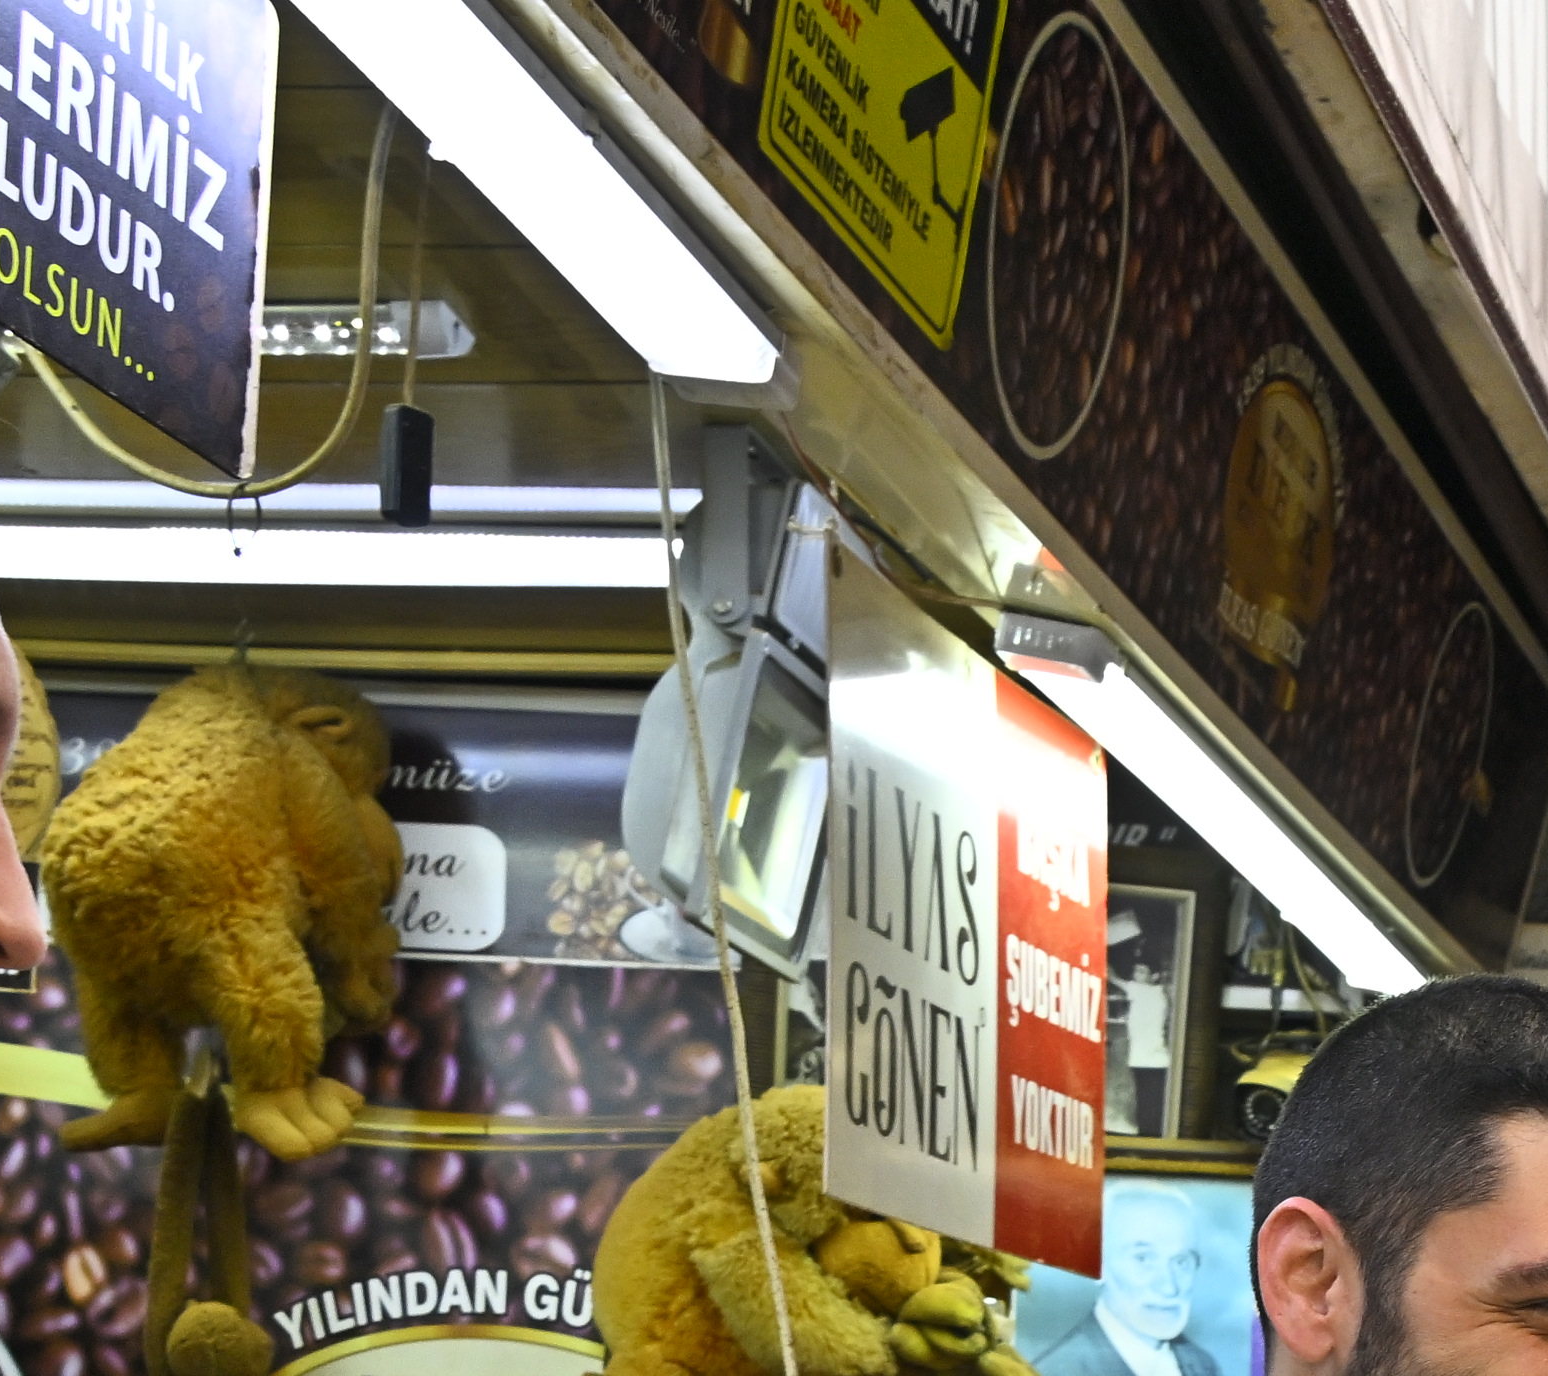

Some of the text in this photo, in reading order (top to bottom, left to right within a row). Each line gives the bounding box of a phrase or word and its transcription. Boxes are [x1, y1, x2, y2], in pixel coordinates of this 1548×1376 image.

[795, 4, 871, 115] GÜVENLİK
[777, 91, 894, 253] İZLENMEKTEDİR
[786, 49, 931, 242] KAMERA SİSTEMİYLE
[846, 761, 979, 986] İLYAS
[1006, 934, 1102, 1044] ŞUBEMİZ
[1011, 1074, 1094, 1169] YOKTUR
[273, 1269, 508, 1351] YILINDAN
